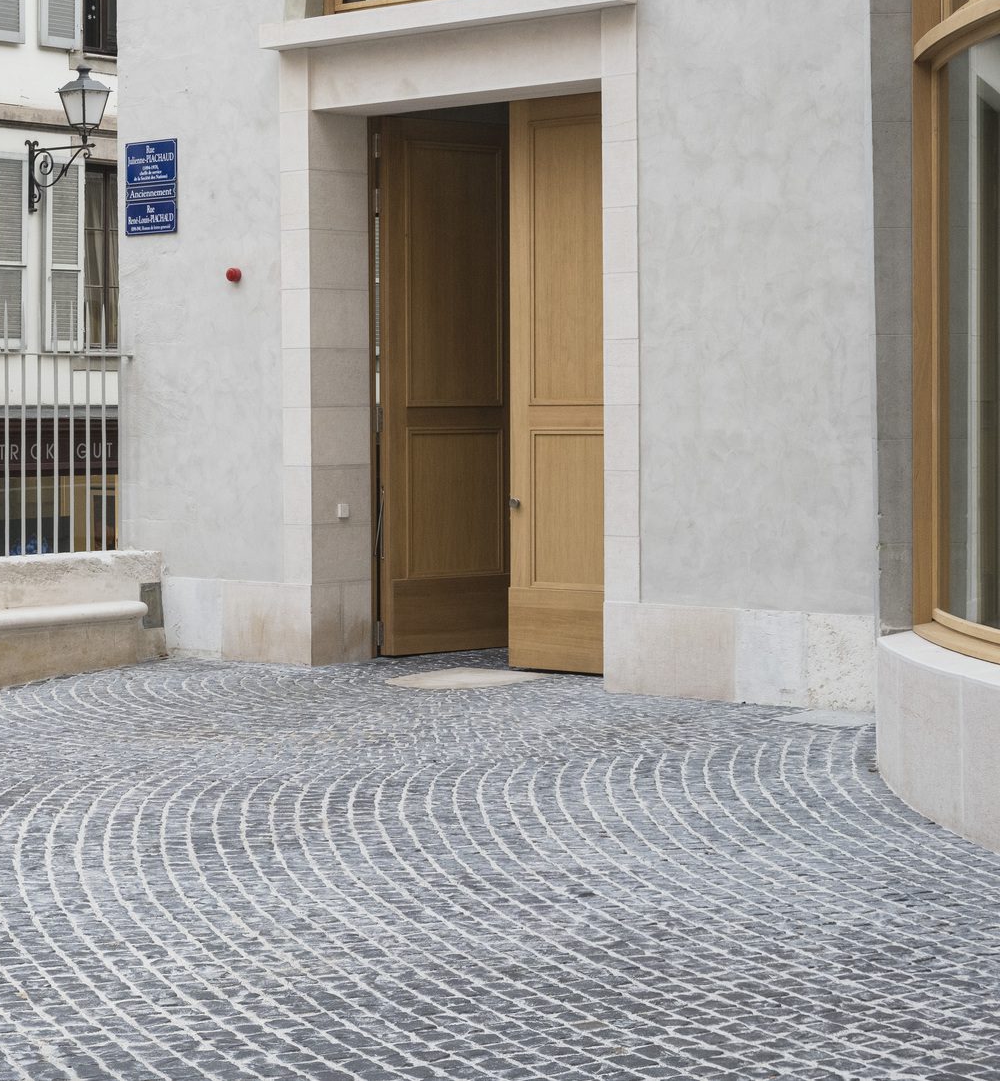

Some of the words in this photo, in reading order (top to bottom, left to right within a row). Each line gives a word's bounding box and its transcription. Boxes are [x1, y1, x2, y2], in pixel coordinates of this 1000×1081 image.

[146, 145, 155, 153] Rue
[130, 189, 172, 198] Anciennement
[146, 205, 155, 213] Rue
